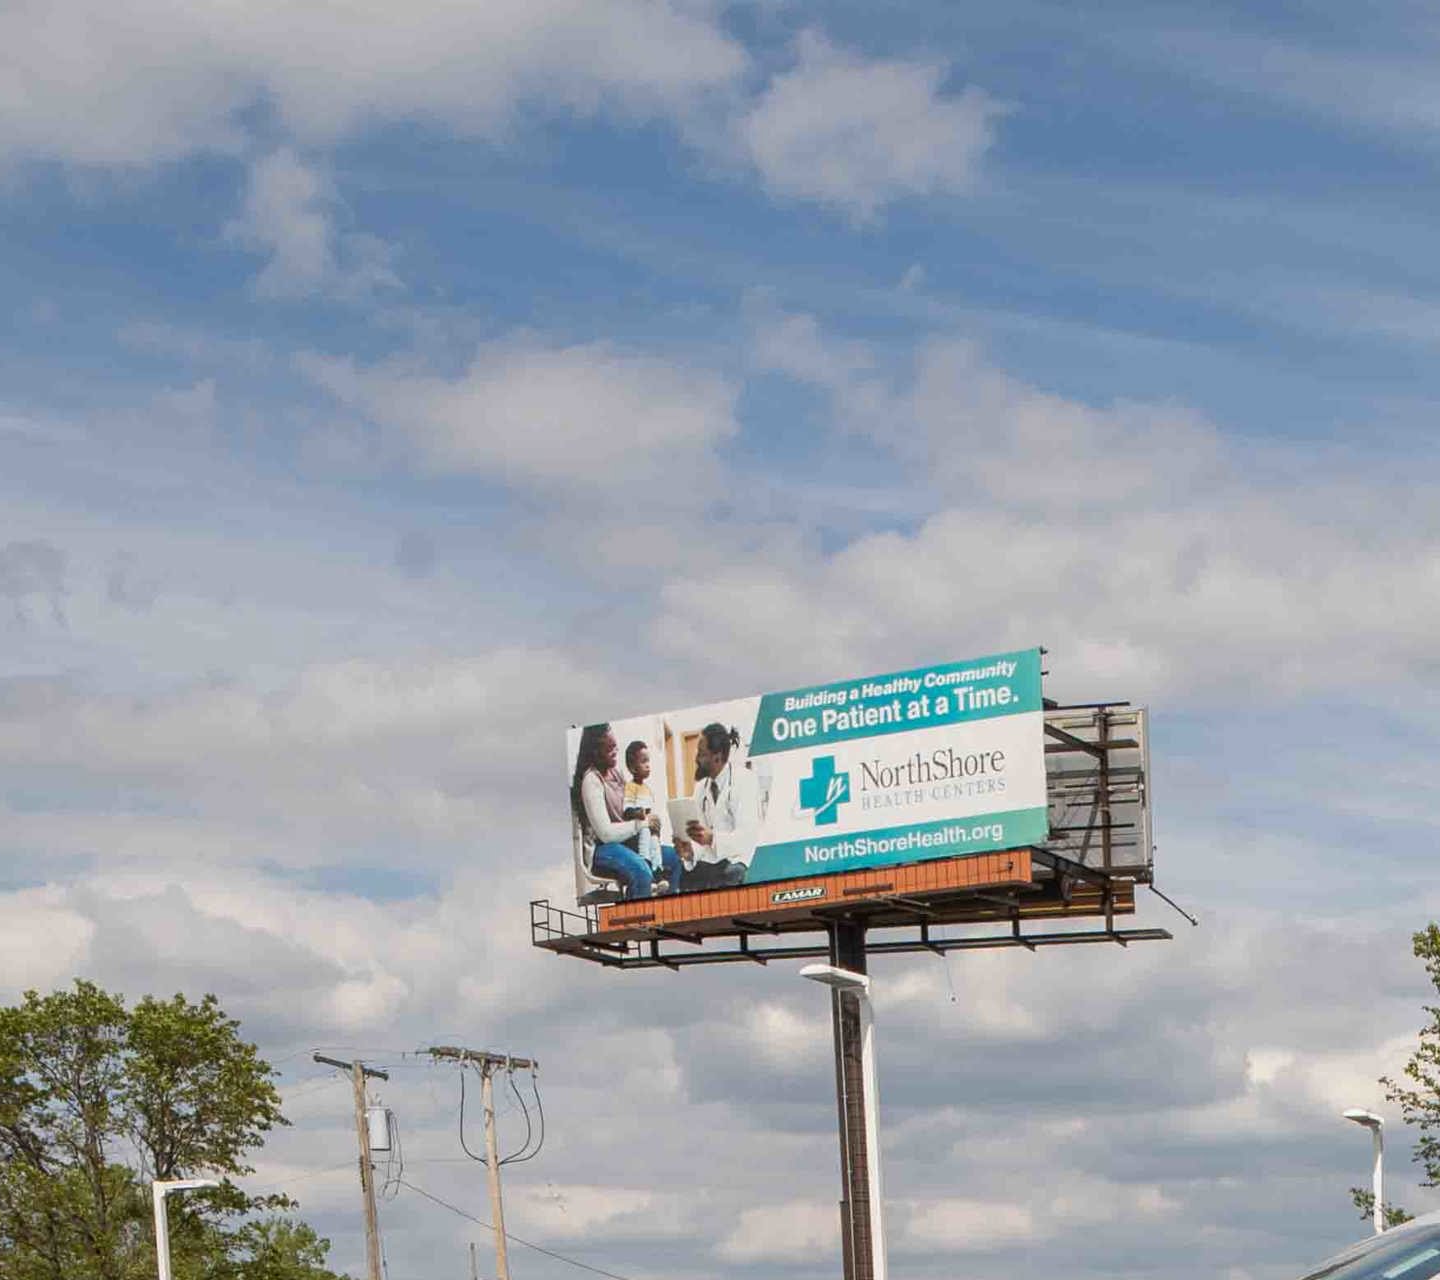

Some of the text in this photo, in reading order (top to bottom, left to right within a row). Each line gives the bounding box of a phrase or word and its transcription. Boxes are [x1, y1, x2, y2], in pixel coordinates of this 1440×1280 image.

[784, 660, 1018, 712] Building a Healthy Community
[772, 685, 1019, 741] One Patient at a Time.
[860, 747, 1006, 791] NorthShore
[862, 778, 1007, 811] HEALTH CENTERS
[804, 823, 1004, 864] NorthShoreHealth.org
[774, 888, 824, 902] LAMAR
